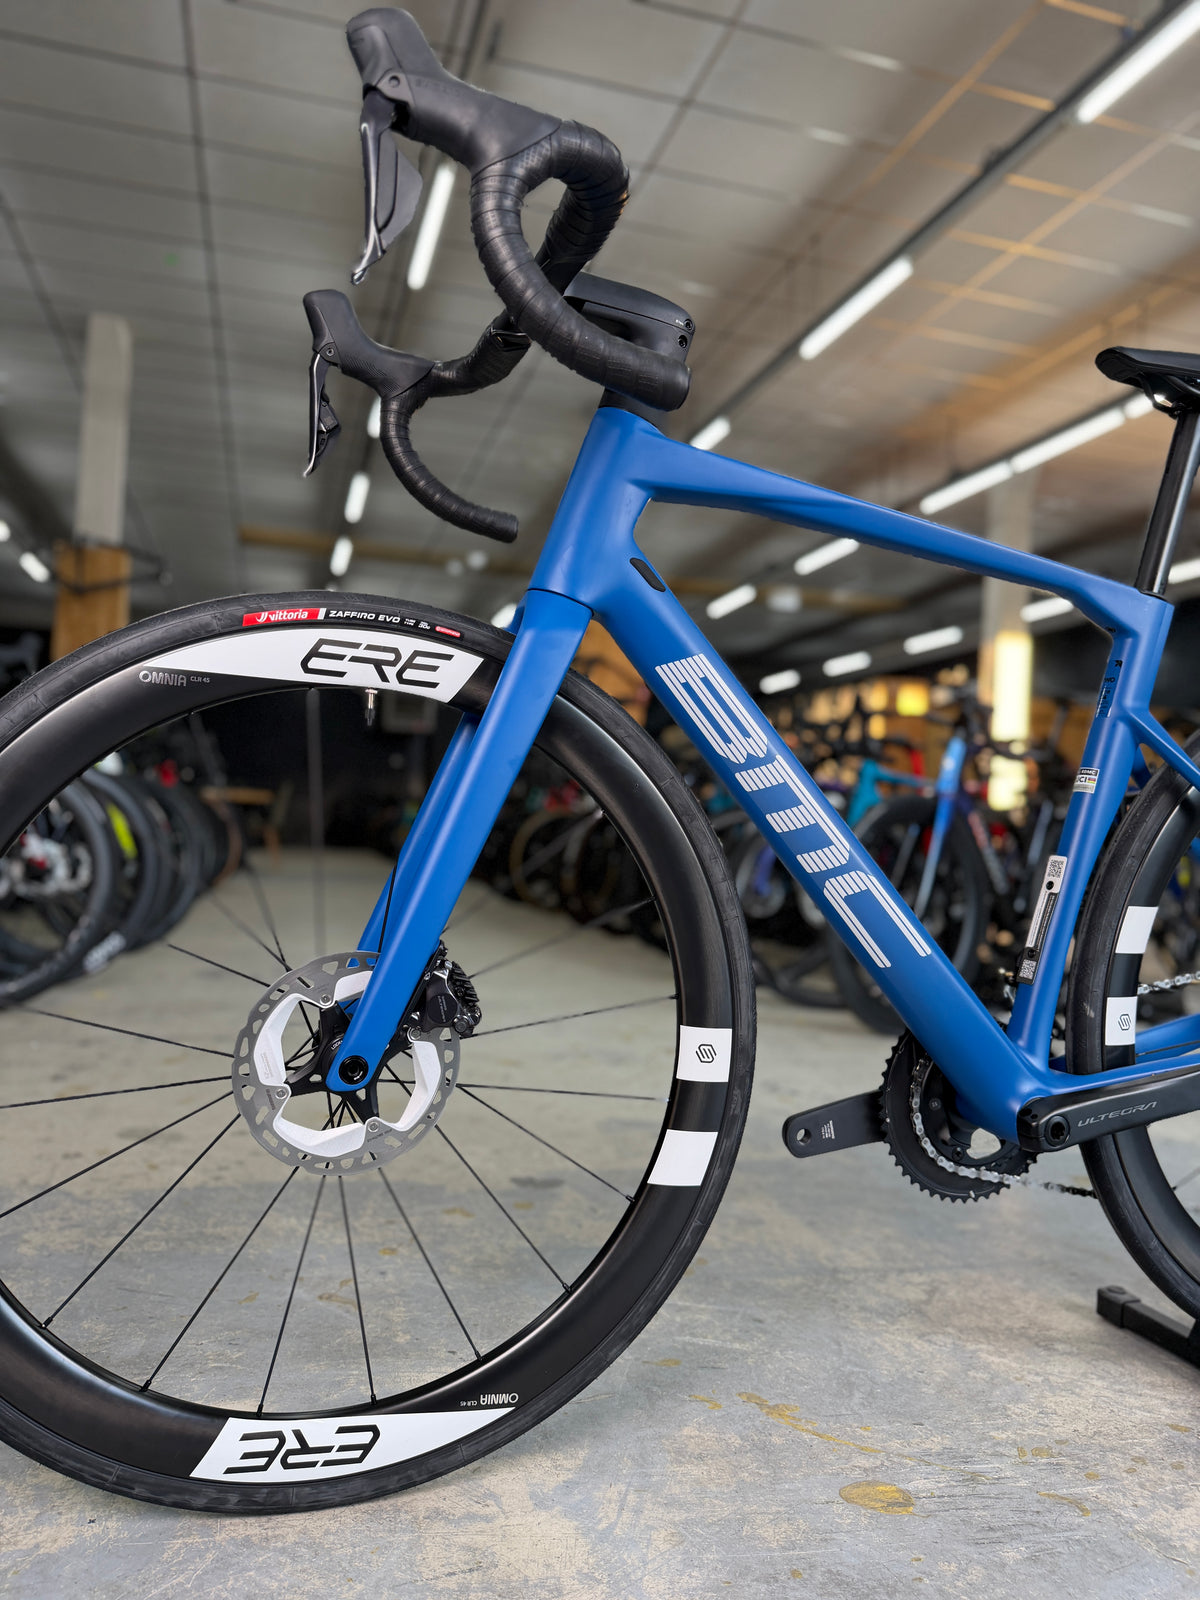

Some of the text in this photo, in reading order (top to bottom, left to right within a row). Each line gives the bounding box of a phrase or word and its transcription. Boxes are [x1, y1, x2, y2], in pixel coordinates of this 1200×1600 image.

[269, 609, 308, 621] vittoria
[329, 610, 400, 623] ZAFFIRO EVO
[300, 638, 454, 689] ERE
[139, 670, 187, 687] OMNIA
[655, 653, 931, 968] BMC
[1078, 1101, 1157, 1127] ULTEGRA
[480, 1392, 519, 1405] OMNIA
[222, 1424, 380, 1474] ERE
